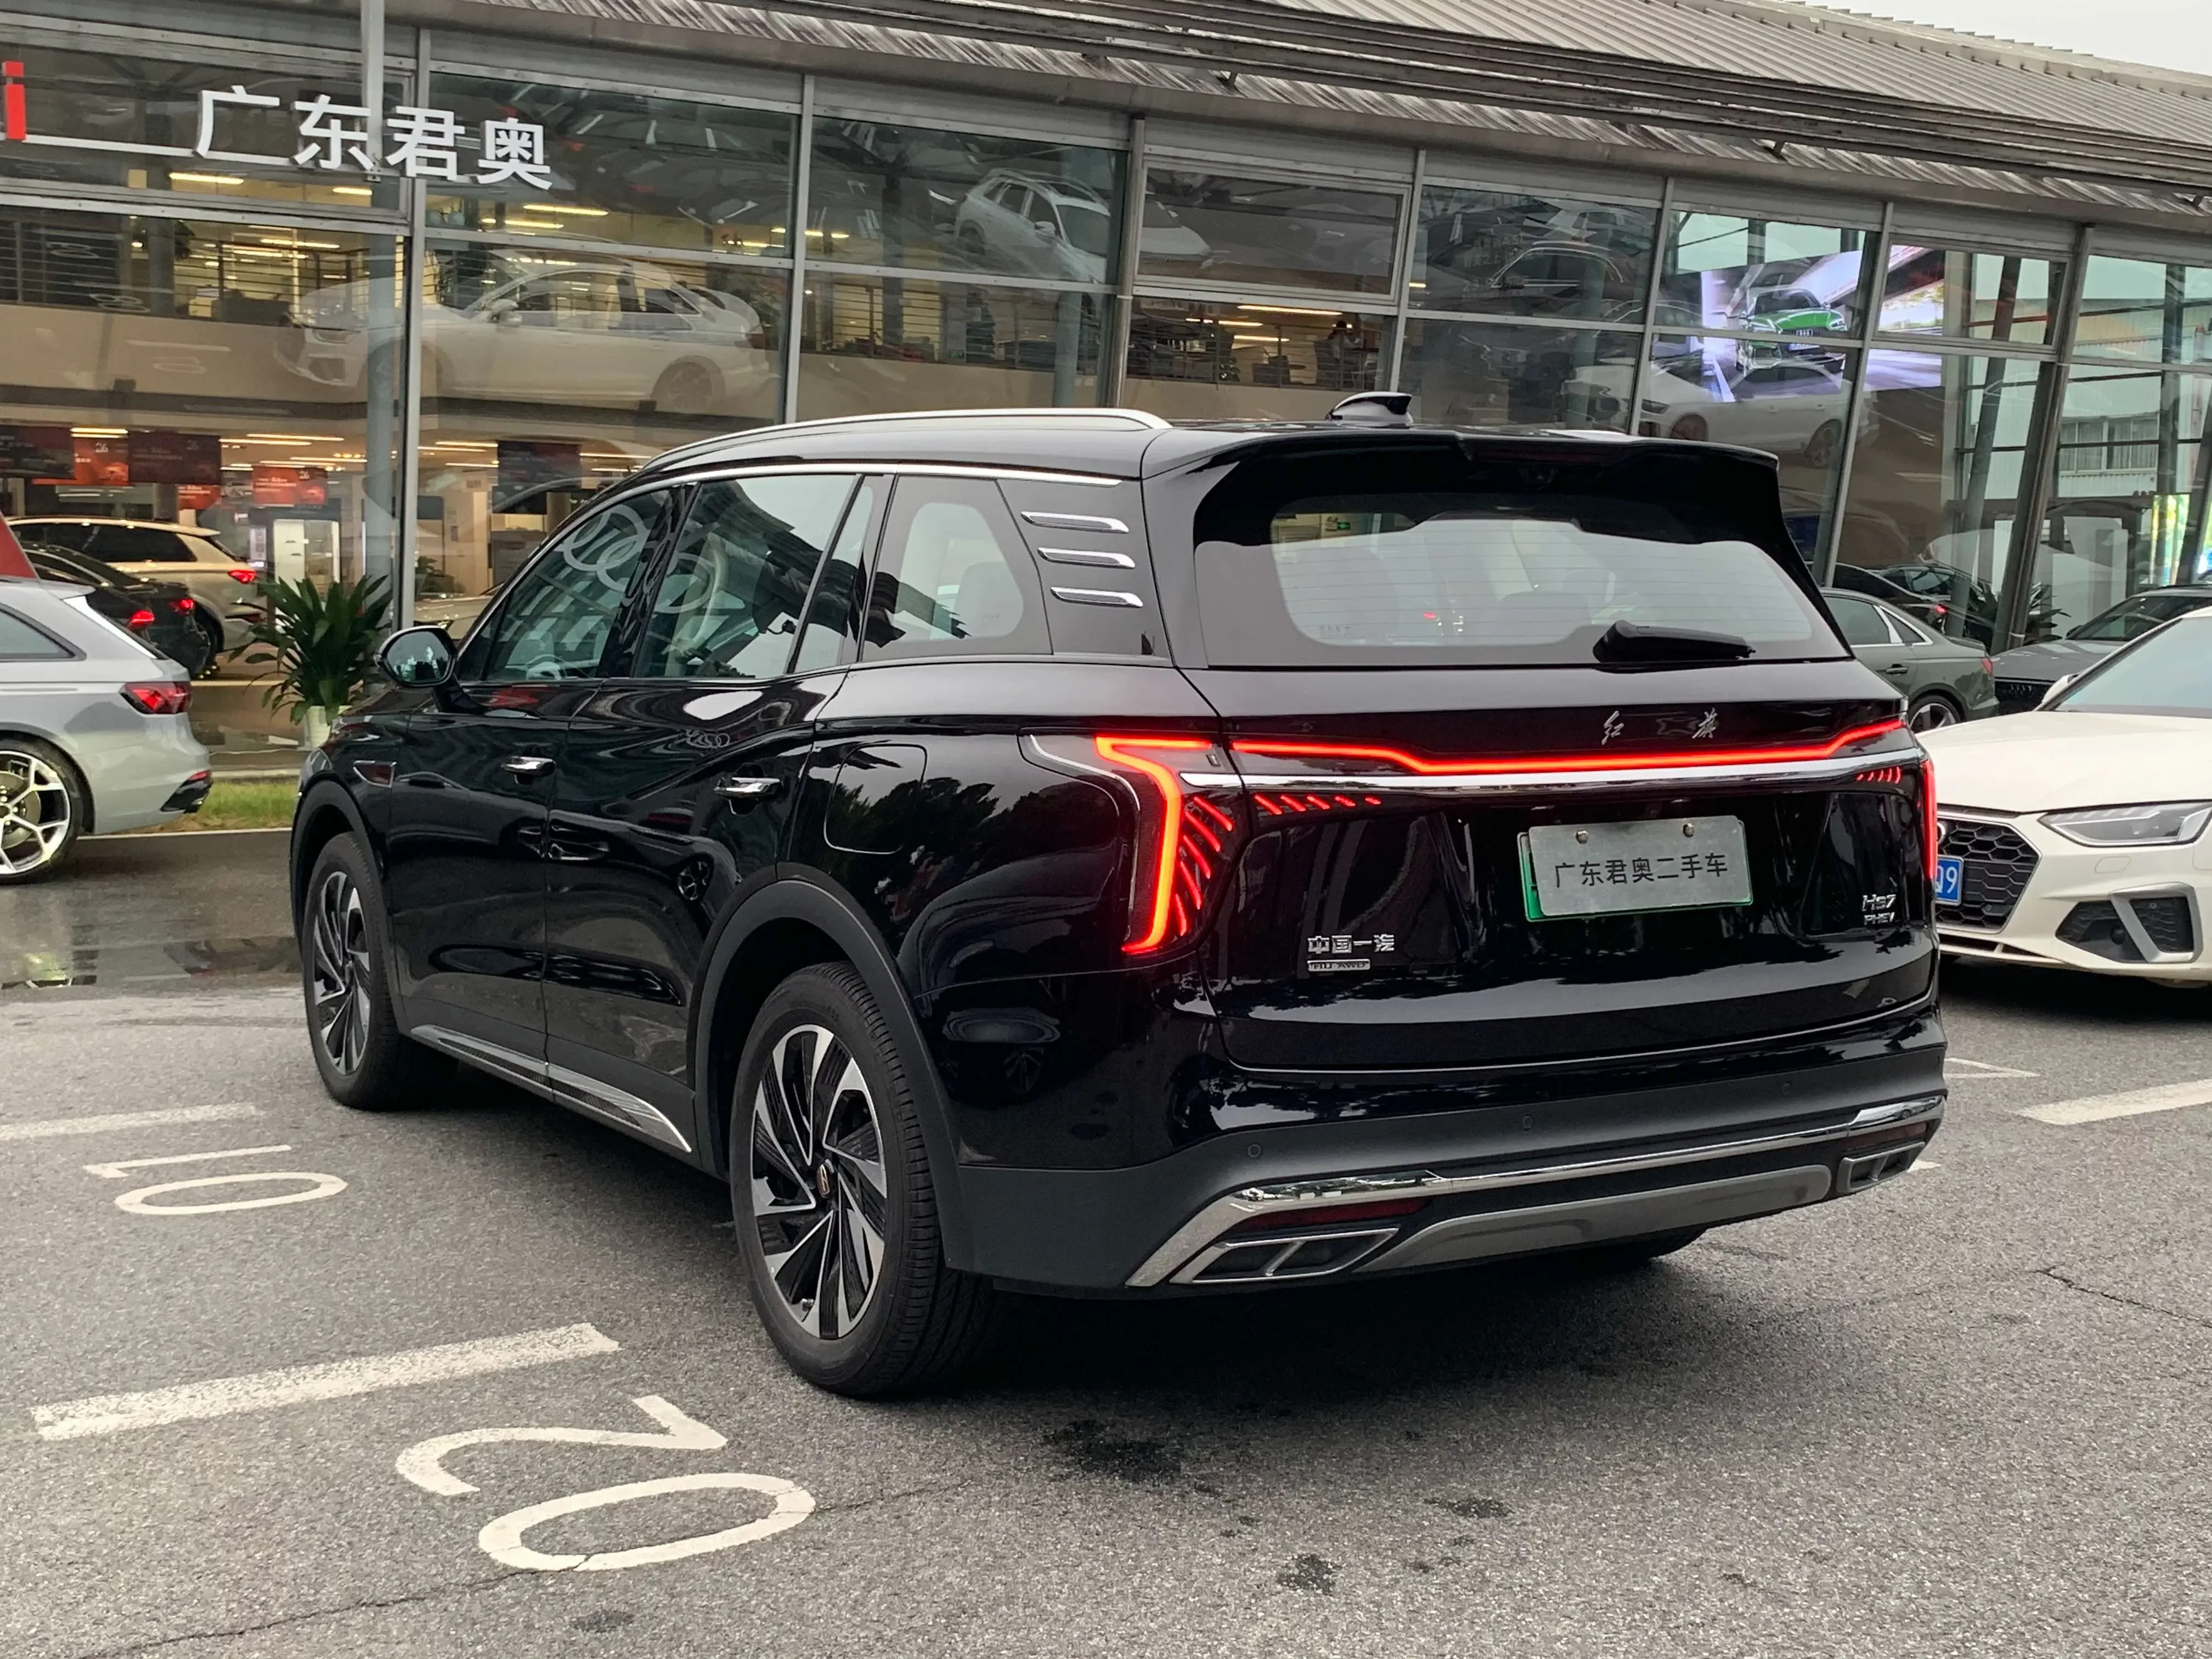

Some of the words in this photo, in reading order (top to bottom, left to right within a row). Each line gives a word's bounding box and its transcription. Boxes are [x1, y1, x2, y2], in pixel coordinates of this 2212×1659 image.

[194, 85, 552, 190] 广东君奥
[1554, 852, 1729, 888] 广东君奥二手车
[1861, 894, 1897, 911] HS7
[1307, 934, 1395, 953] 中国一汽
